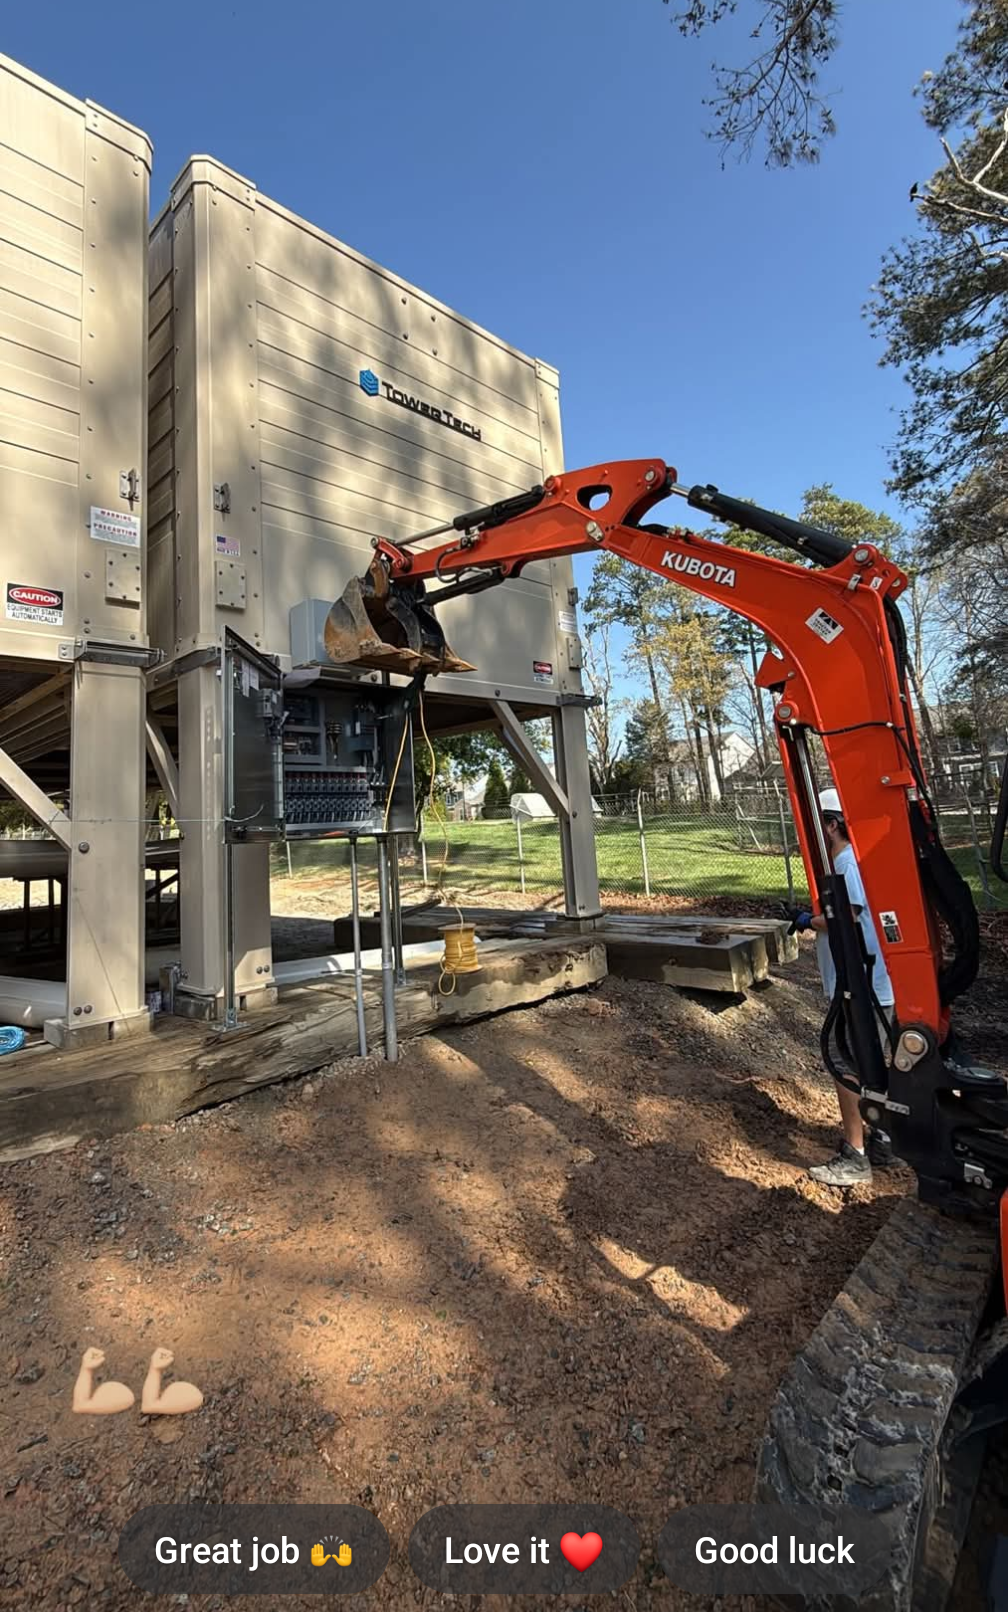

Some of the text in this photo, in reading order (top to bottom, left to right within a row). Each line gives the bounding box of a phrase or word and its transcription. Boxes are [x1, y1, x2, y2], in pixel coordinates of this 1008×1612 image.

[660, 550, 737, 588] KUBOTA
[12, 590, 58, 604] CAUTION
[7, 603, 63, 618] EQUIPMENT STARTS
[11, 611, 58, 624] AUTOMATICALLY
